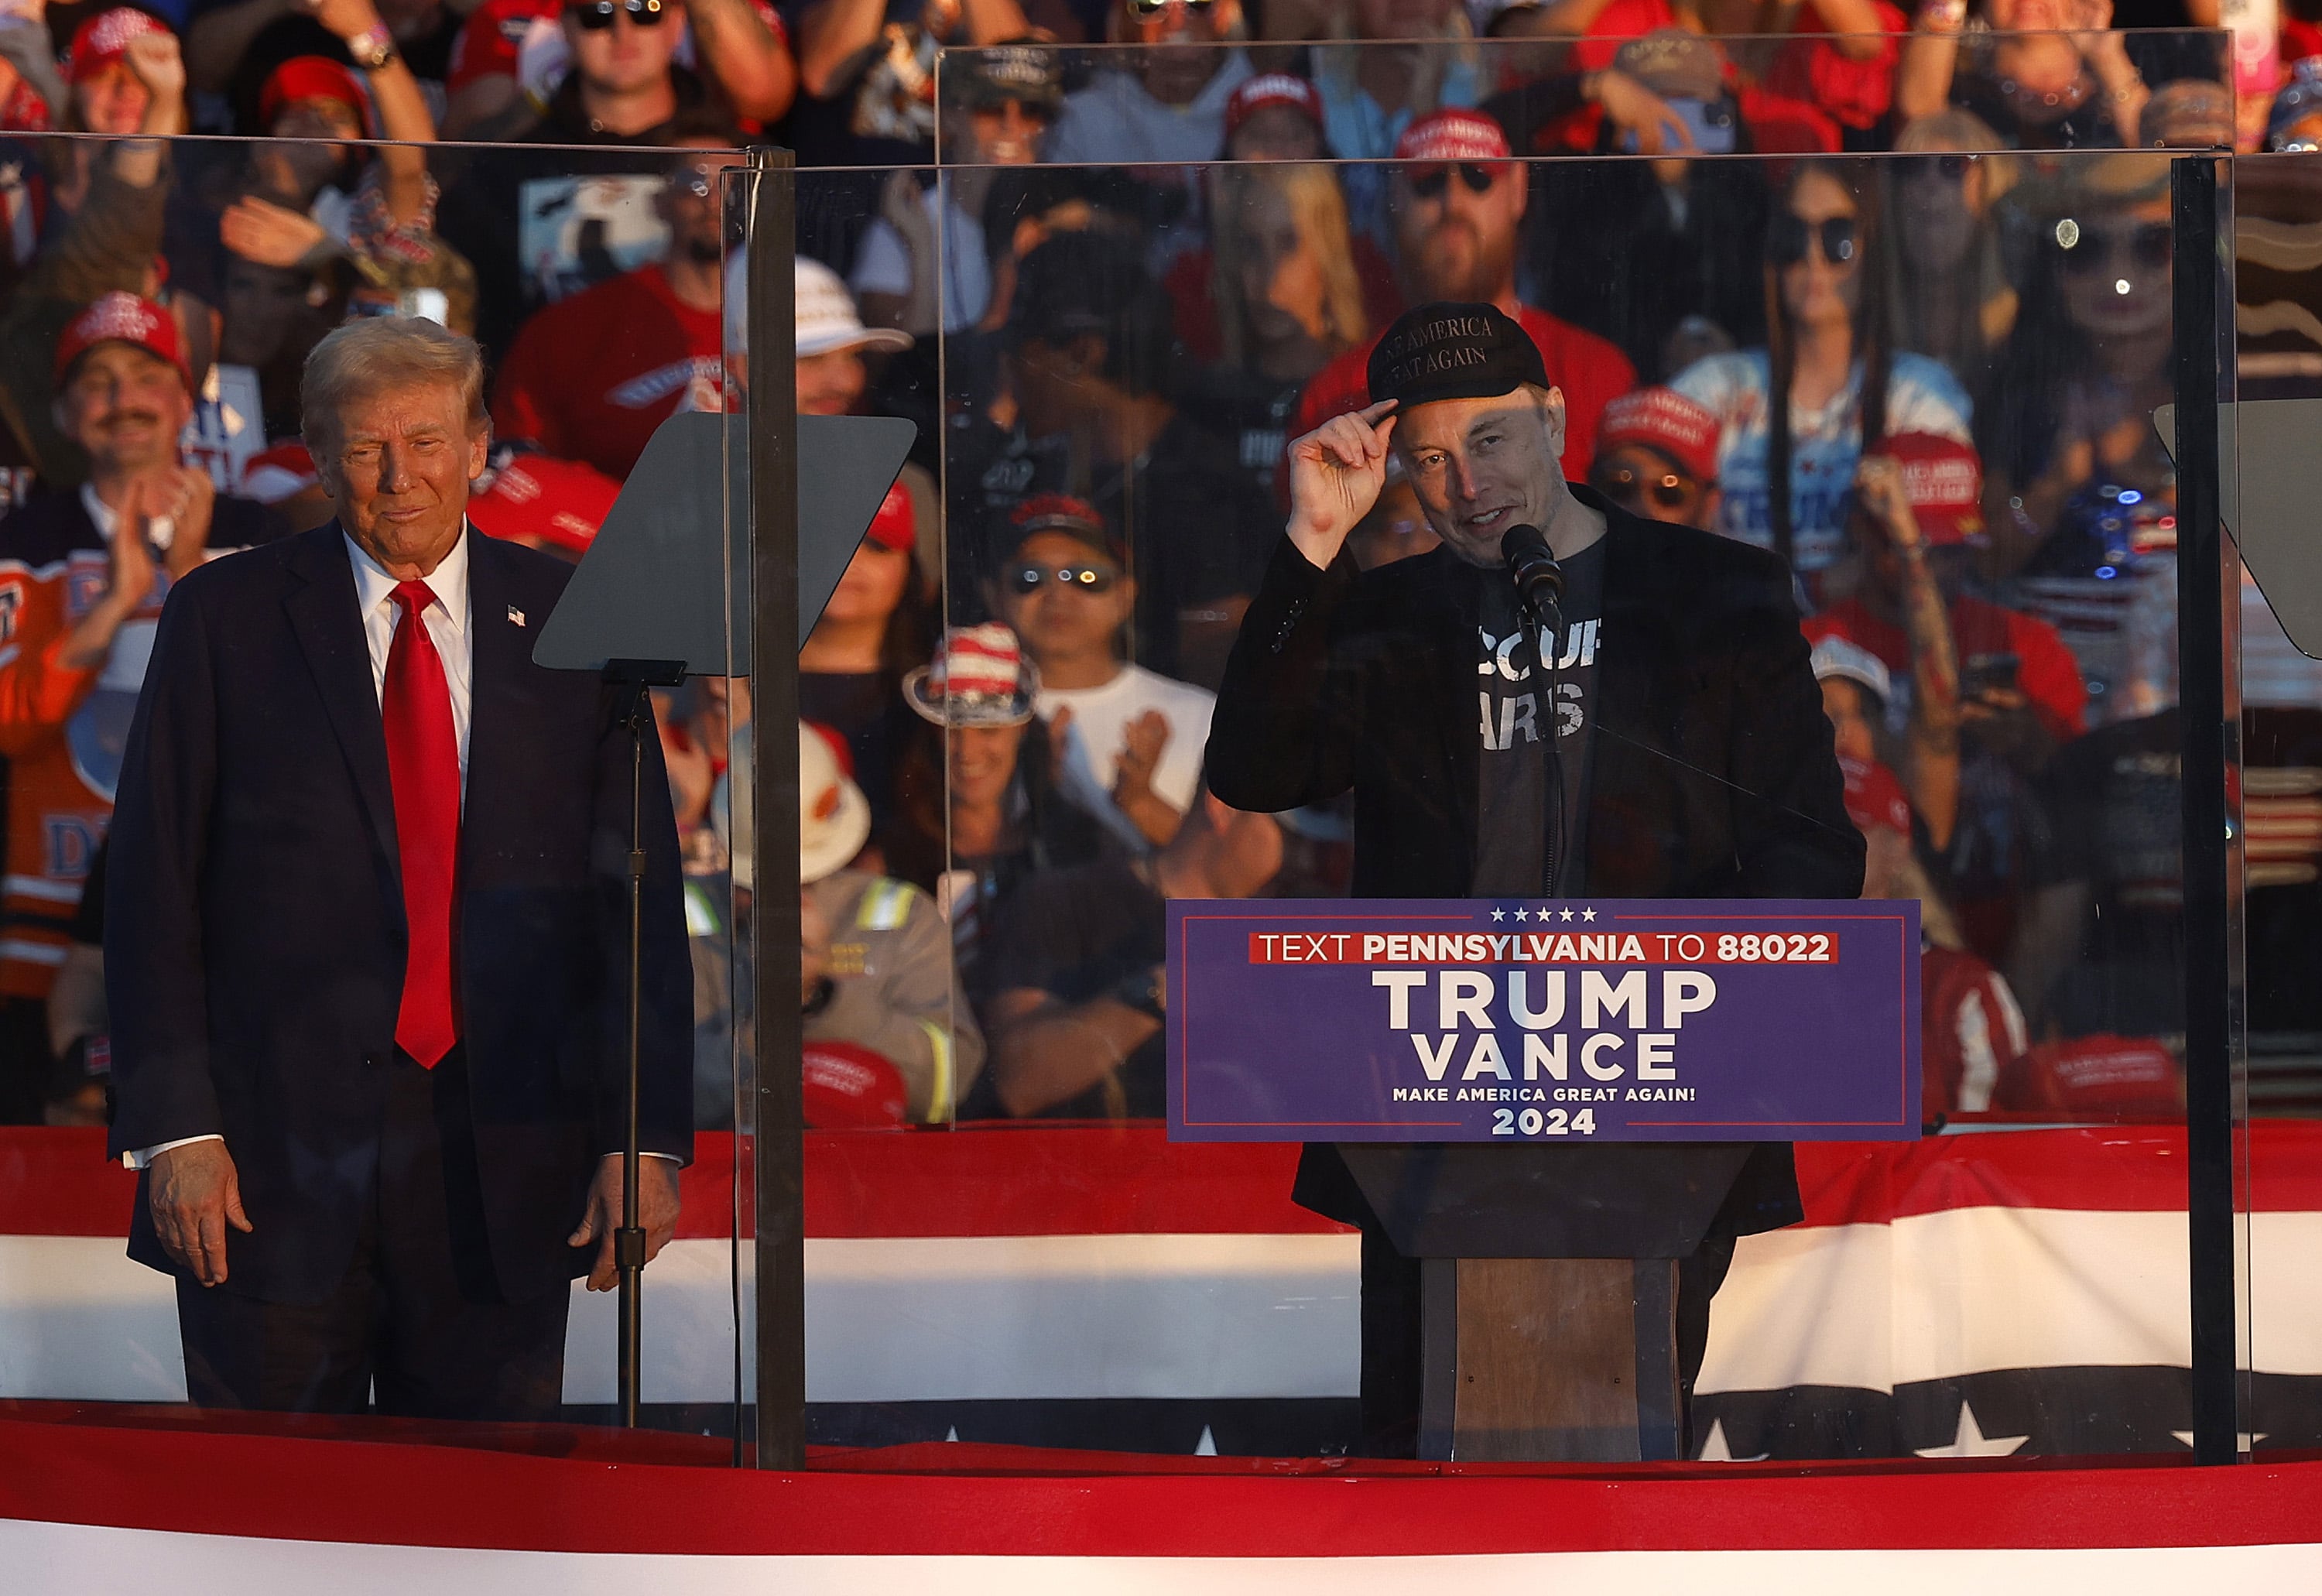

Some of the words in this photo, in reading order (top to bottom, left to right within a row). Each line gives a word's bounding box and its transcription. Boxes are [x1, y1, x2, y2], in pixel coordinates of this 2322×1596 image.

[1406, 315, 1494, 352] AMERICA
[1426, 346, 1488, 375] AGAIN
[1258, 933, 1351, 961] TEXT
[1362, 933, 1646, 962] PENNSYLVANIA
[1655, 933, 1705, 961] TO
[1716, 933, 1831, 961] 88022
[1372, 970, 1718, 1030] TRUMP
[1410, 1032, 1676, 1081] VANCE
[1393, 1087, 1449, 1101] MAKE
[1455, 1087, 1546, 1101] AMERICA
[1553, 1087, 1618, 1101] GREAT
[1625, 1087, 1696, 1101] AGAIN!
[1492, 1108, 1597, 1135] 2024
